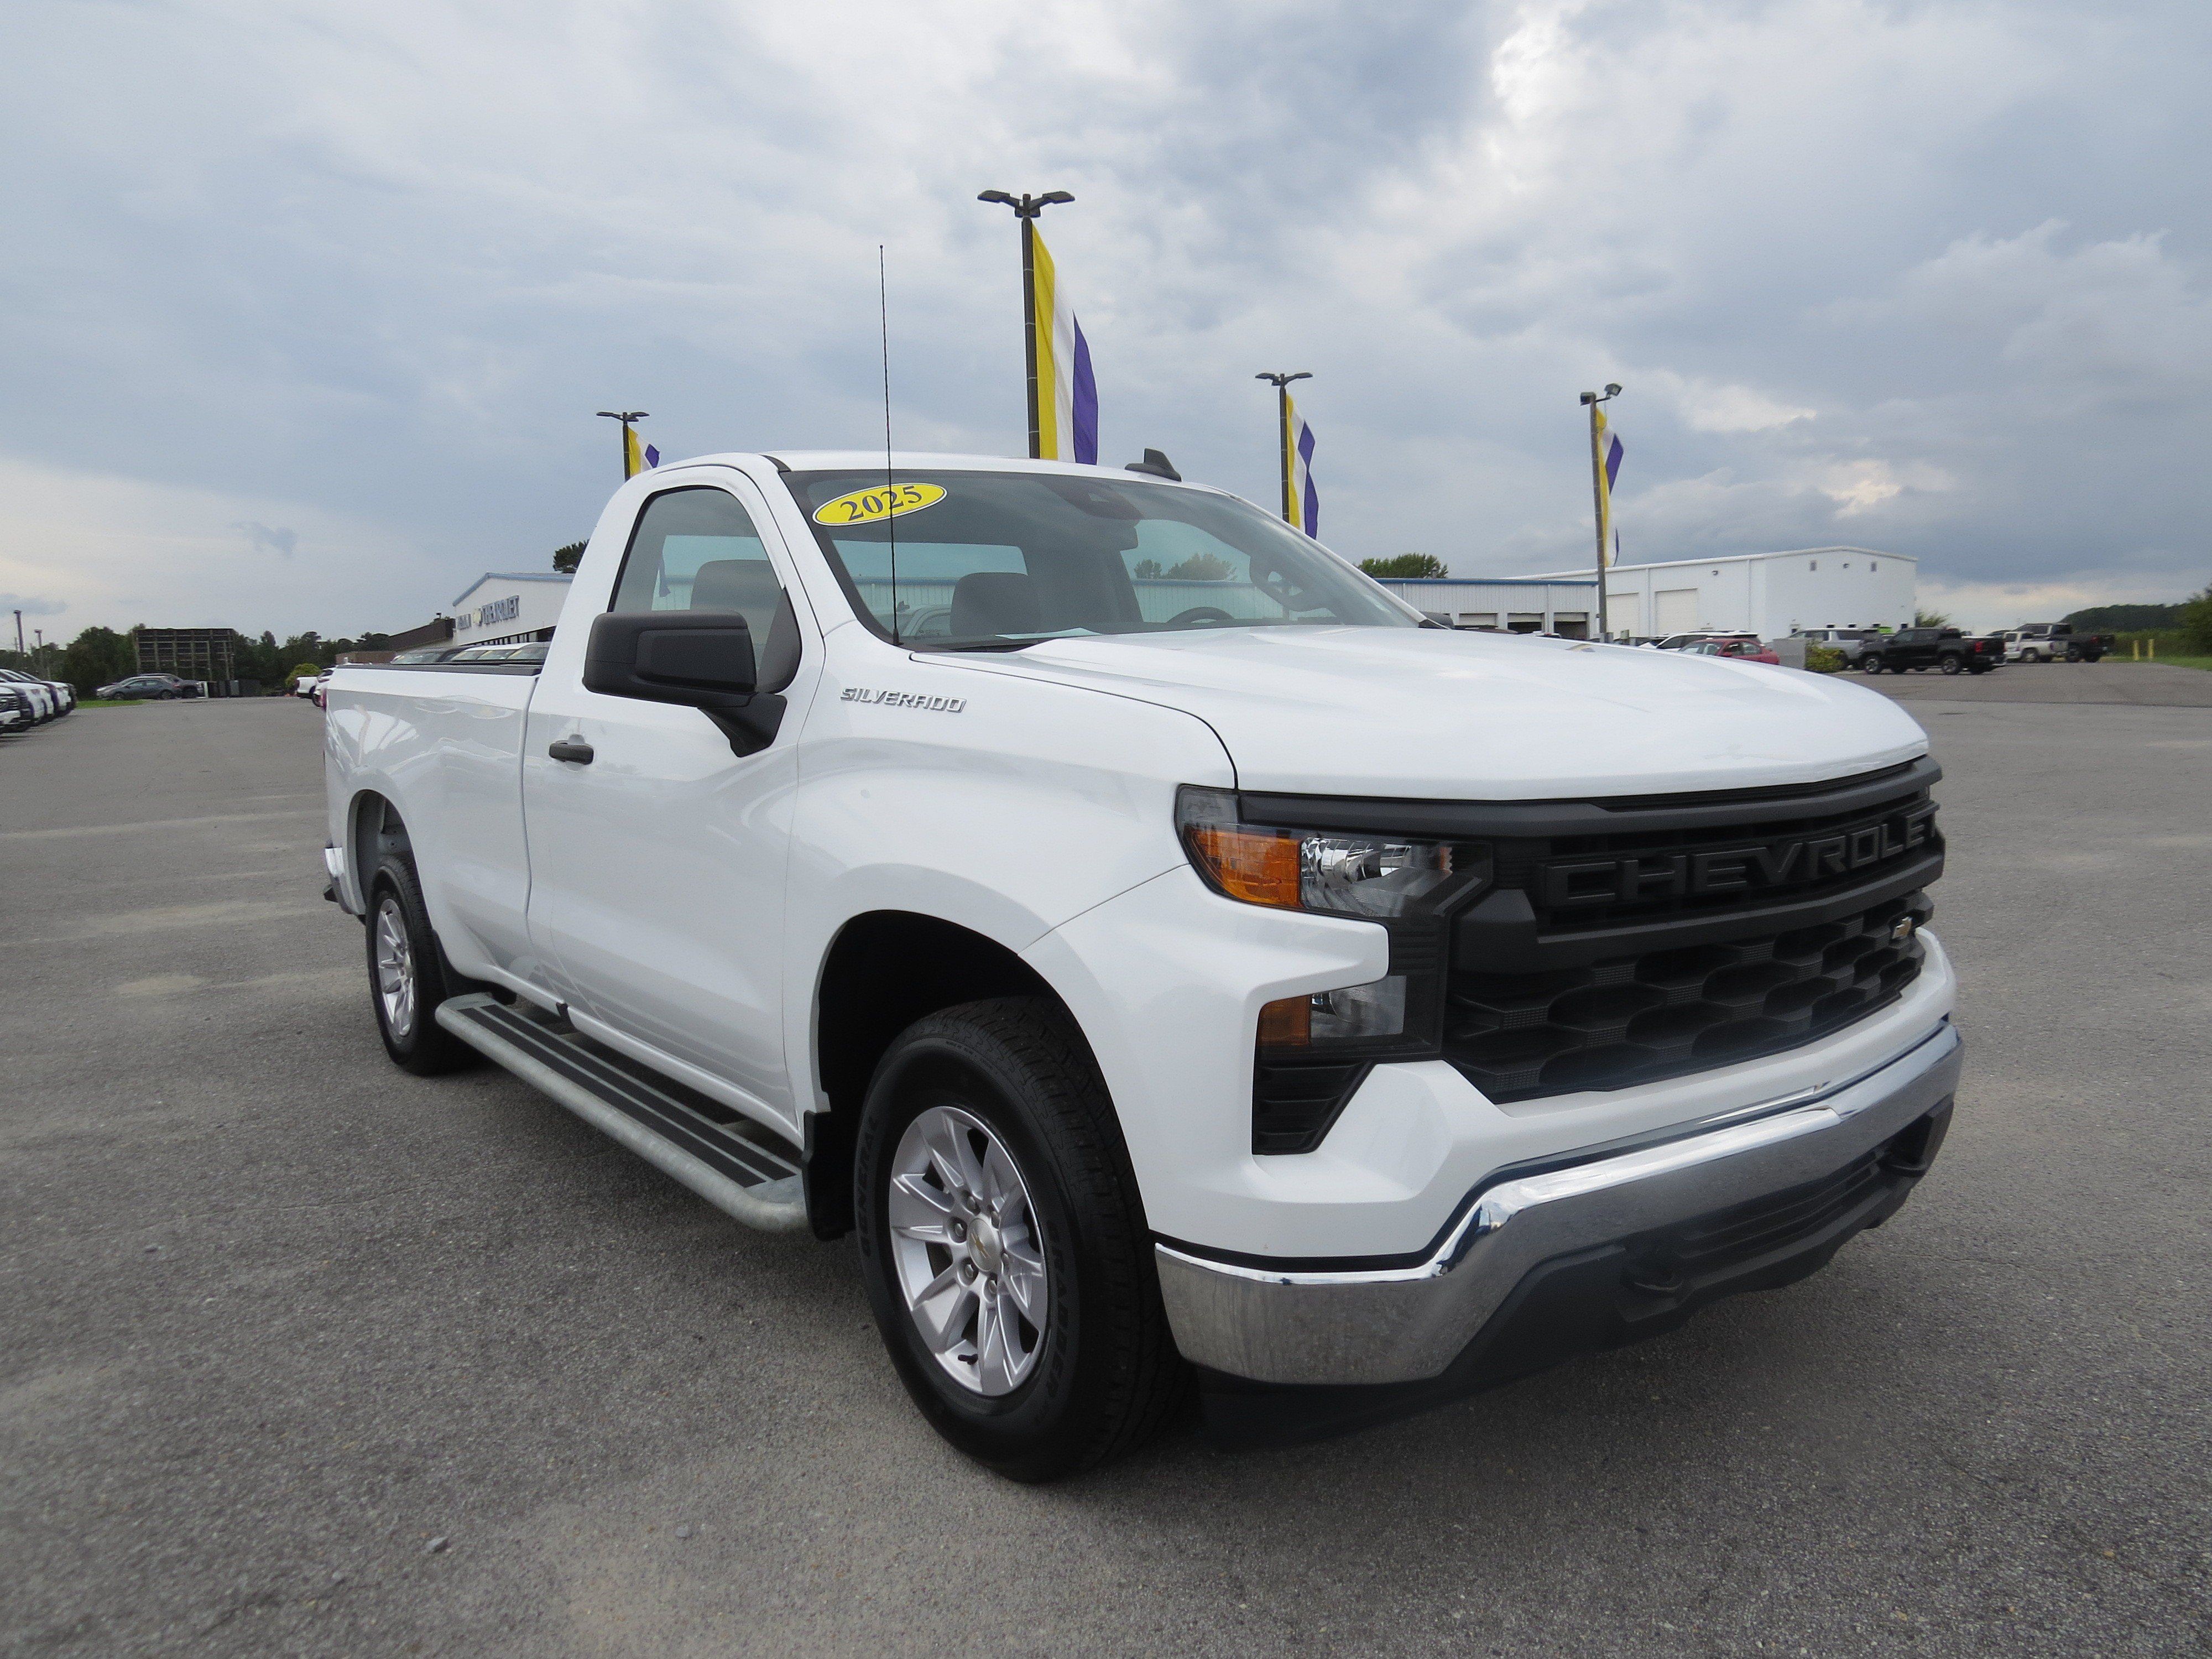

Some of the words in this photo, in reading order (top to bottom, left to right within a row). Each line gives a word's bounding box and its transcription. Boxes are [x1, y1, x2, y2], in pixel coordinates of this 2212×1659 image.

[840, 485, 922, 521] 2025
[839, 687, 968, 713] SILVERADO
[1549, 804, 1940, 906] CHEVROLET
